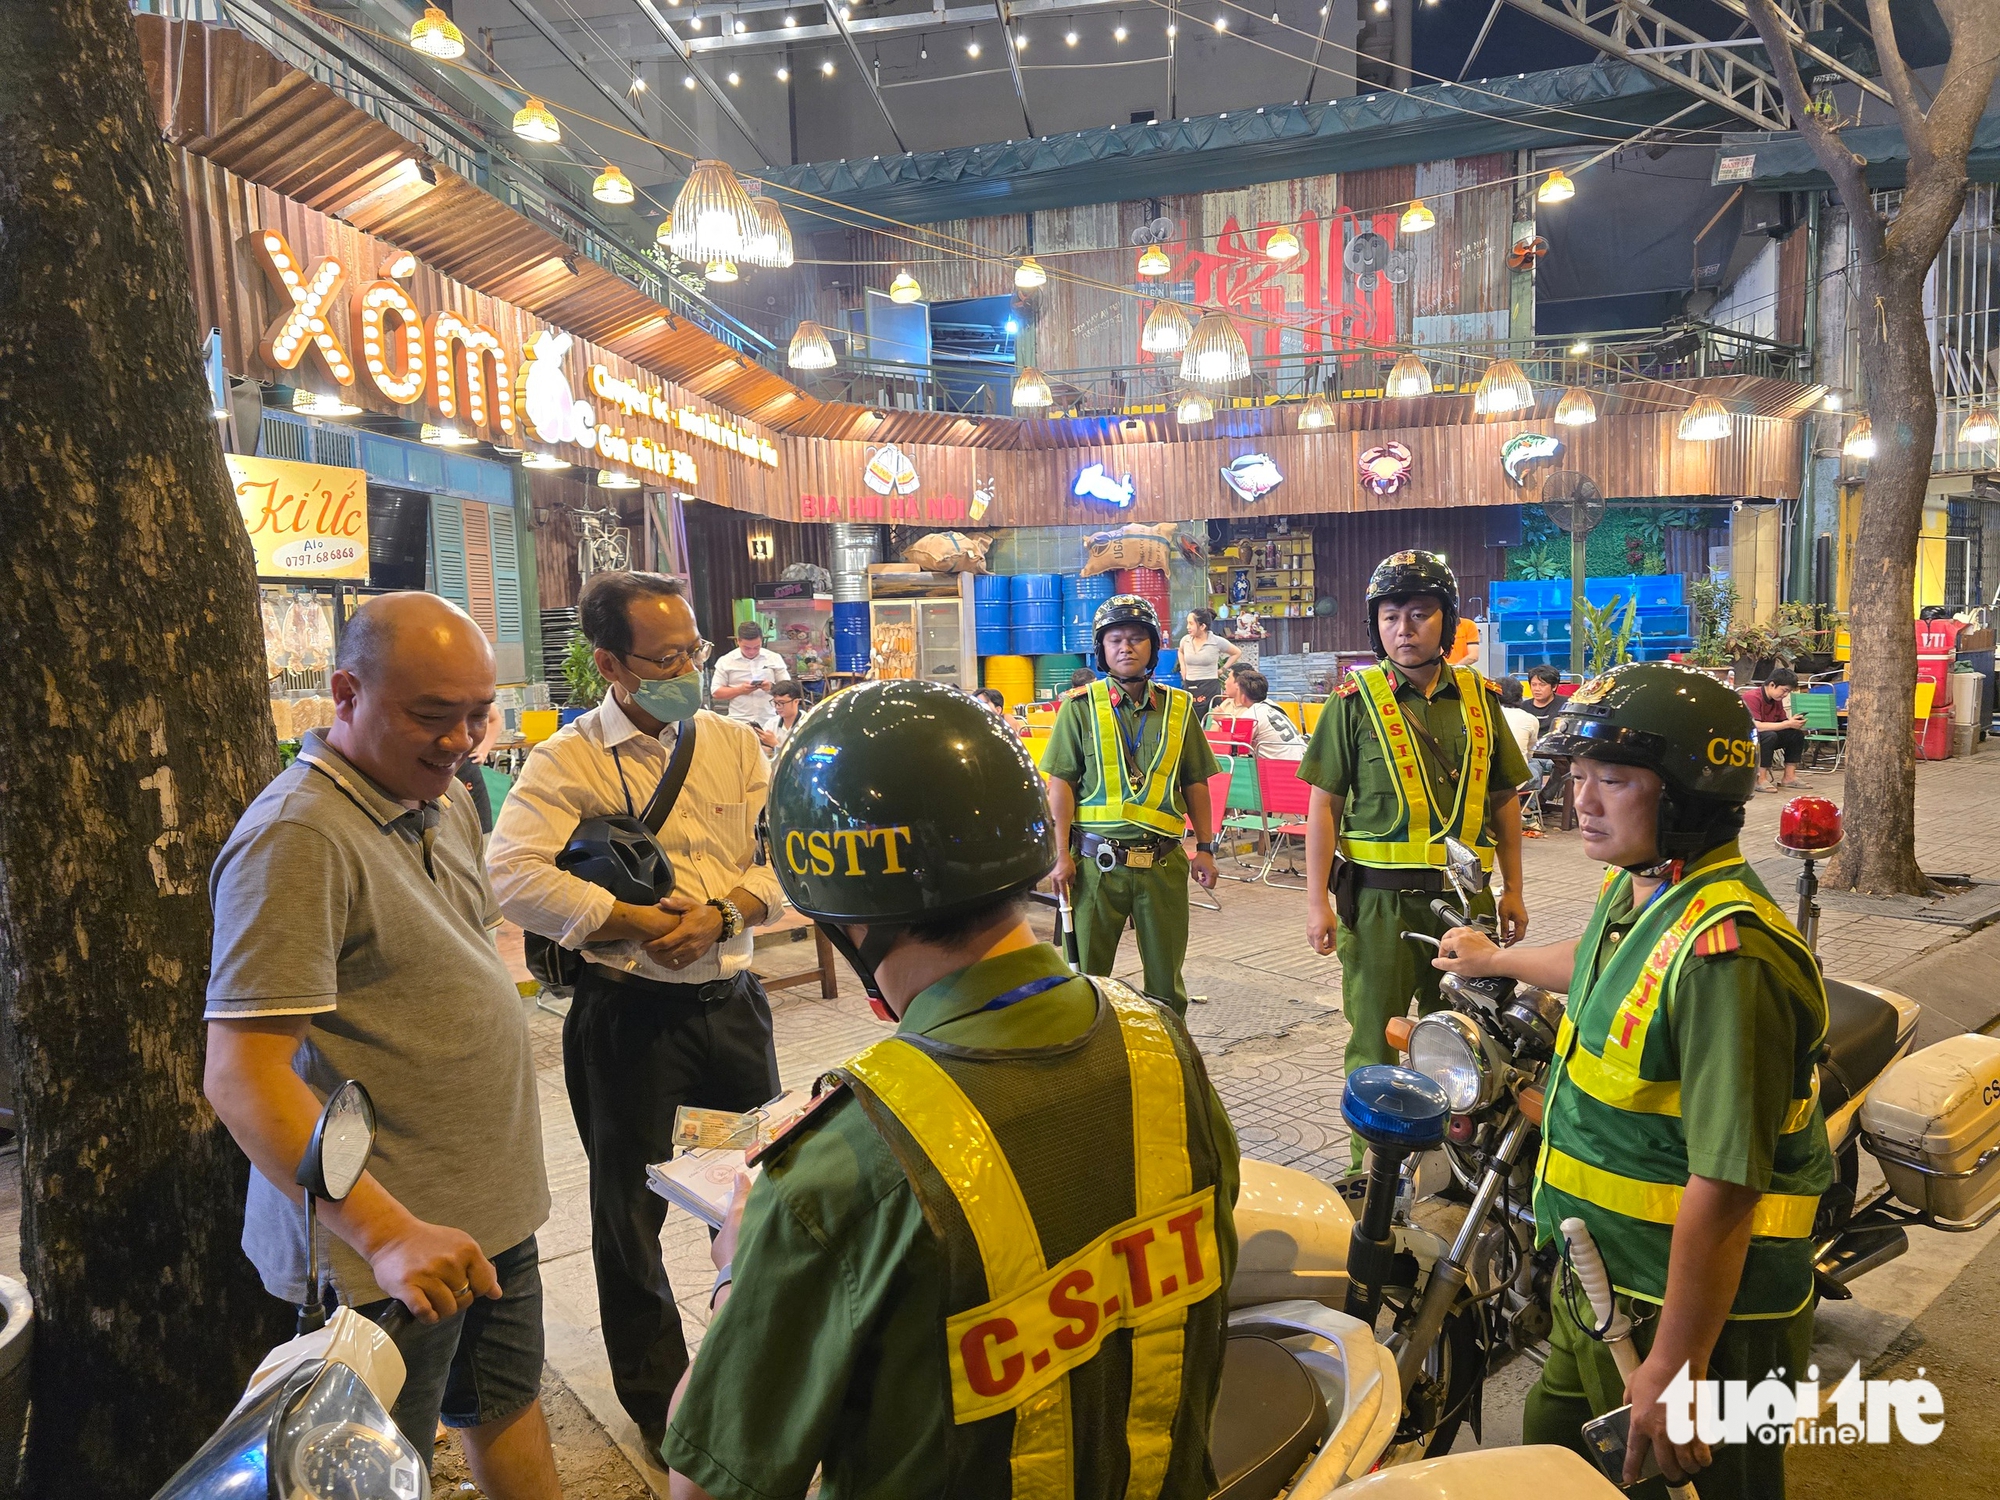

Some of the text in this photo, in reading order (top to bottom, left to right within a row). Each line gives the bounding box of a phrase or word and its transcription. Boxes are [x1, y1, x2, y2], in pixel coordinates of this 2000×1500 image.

[801, 495, 842, 518] BIA
[889, 493, 920, 520] HÀ
[927, 492, 966, 522] NỘI
[1382, 703, 1414, 779] CSTT
[1469, 706, 1485, 781] CSTT
[785, 825, 912, 877] CSTT
[959, 1205, 1205, 1398] C.S.T.T
